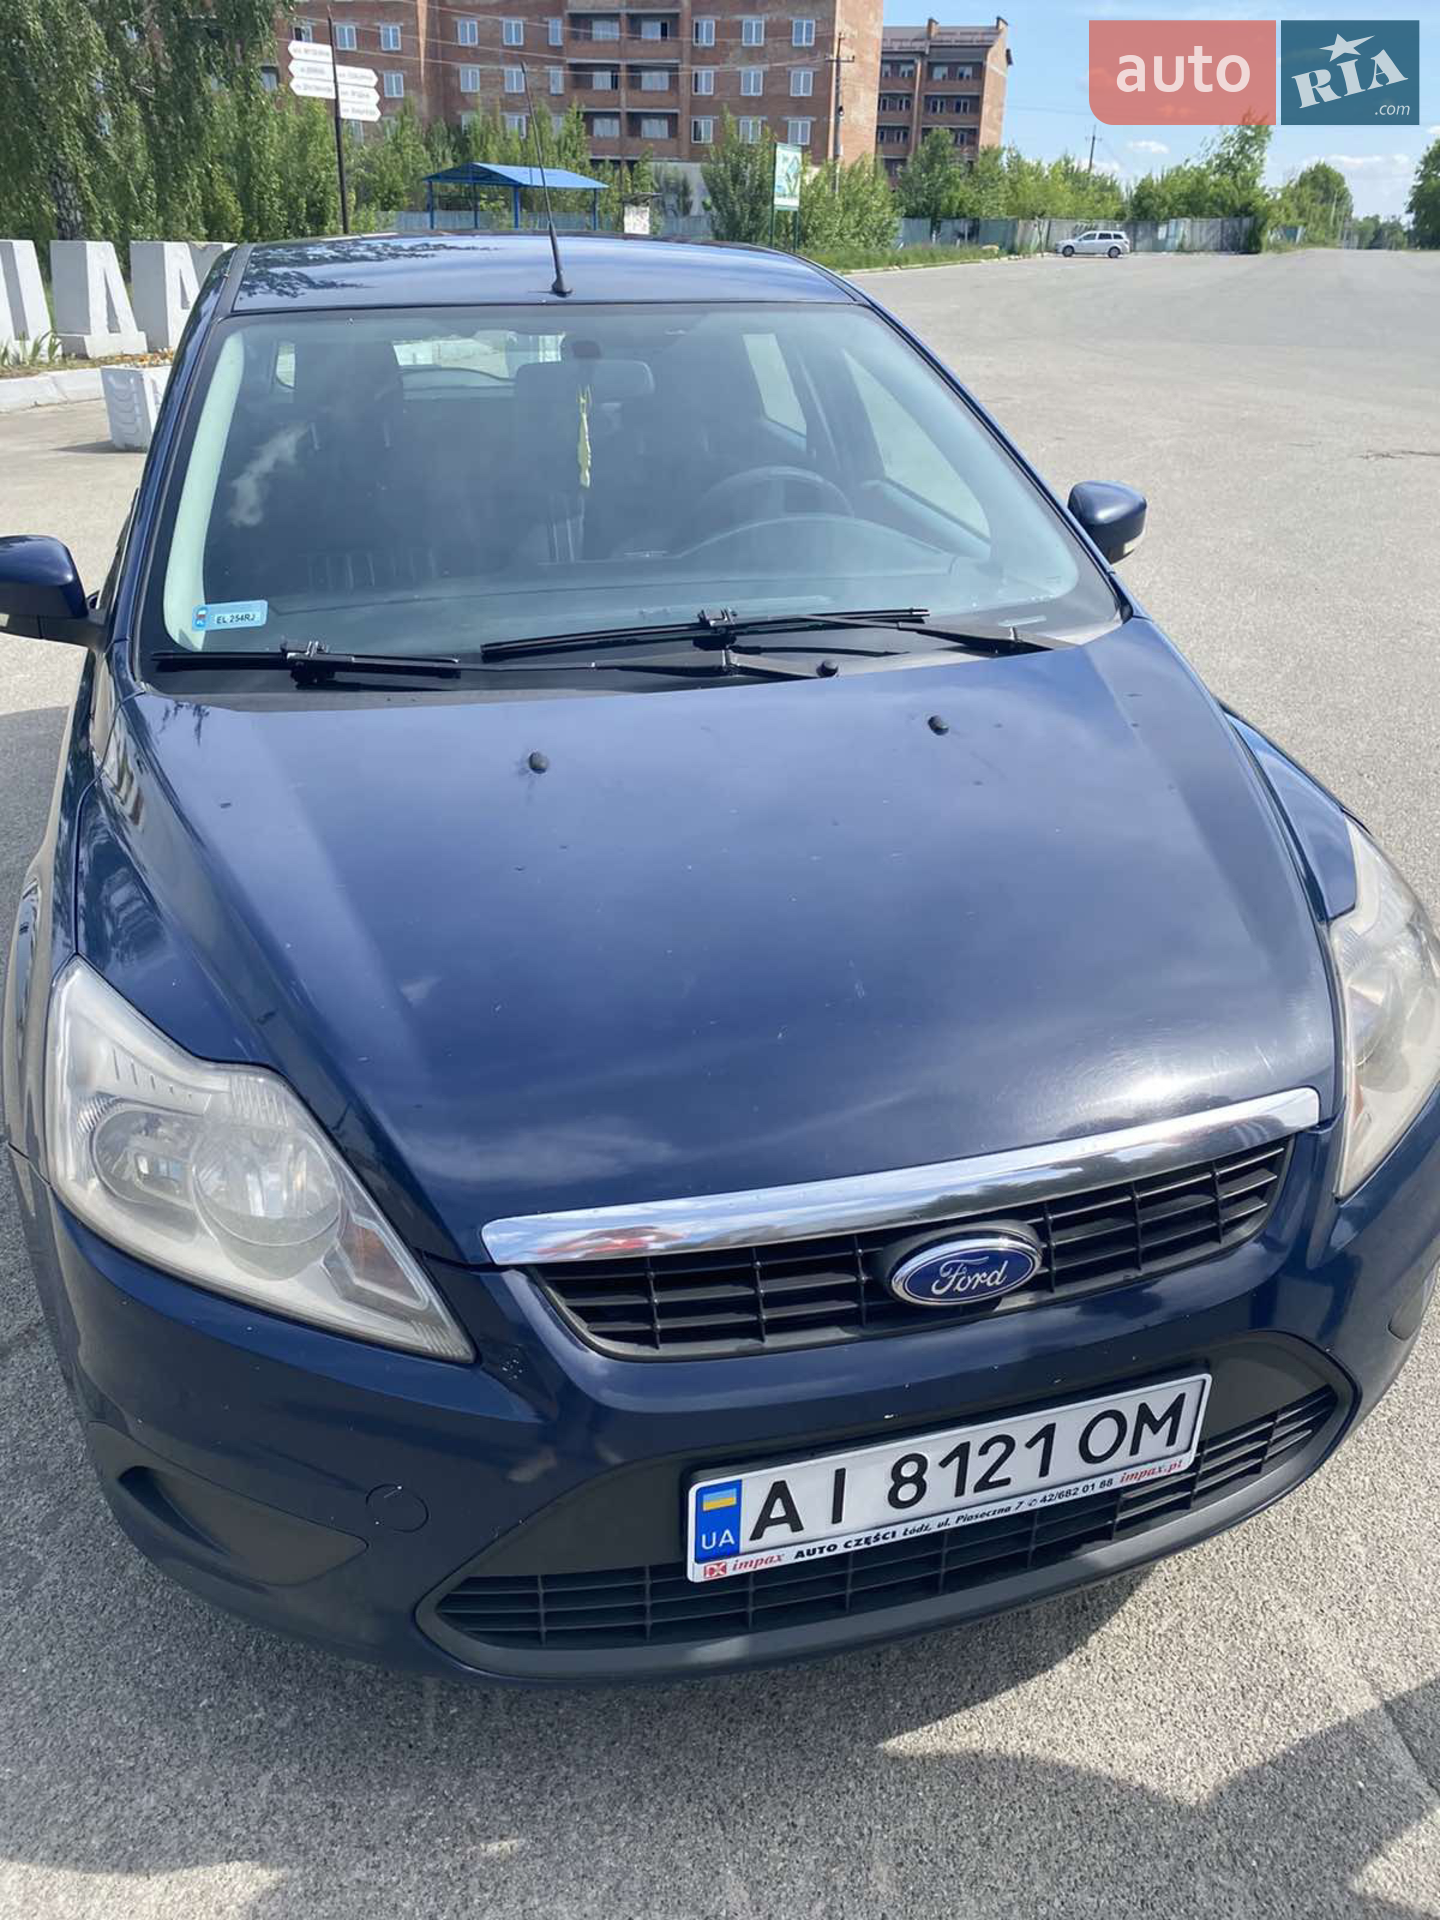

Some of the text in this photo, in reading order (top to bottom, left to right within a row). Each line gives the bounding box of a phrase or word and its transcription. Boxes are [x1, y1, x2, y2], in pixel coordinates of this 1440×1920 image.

[216, 616, 227, 624] EL
[931, 1256, 1009, 1295] Ford
[749, 1392, 1187, 1541] AI 8121 OM
[732, 1553, 785, 1571] impax
[794, 1543, 838, 1559] AUTO
[843, 1530, 897, 1548] CZĘŚCI
[1081, 1483, 1096, 1494] 01
[1119, 1459, 1183, 1484] impax.pl
[701, 1529, 735, 1550] UA
